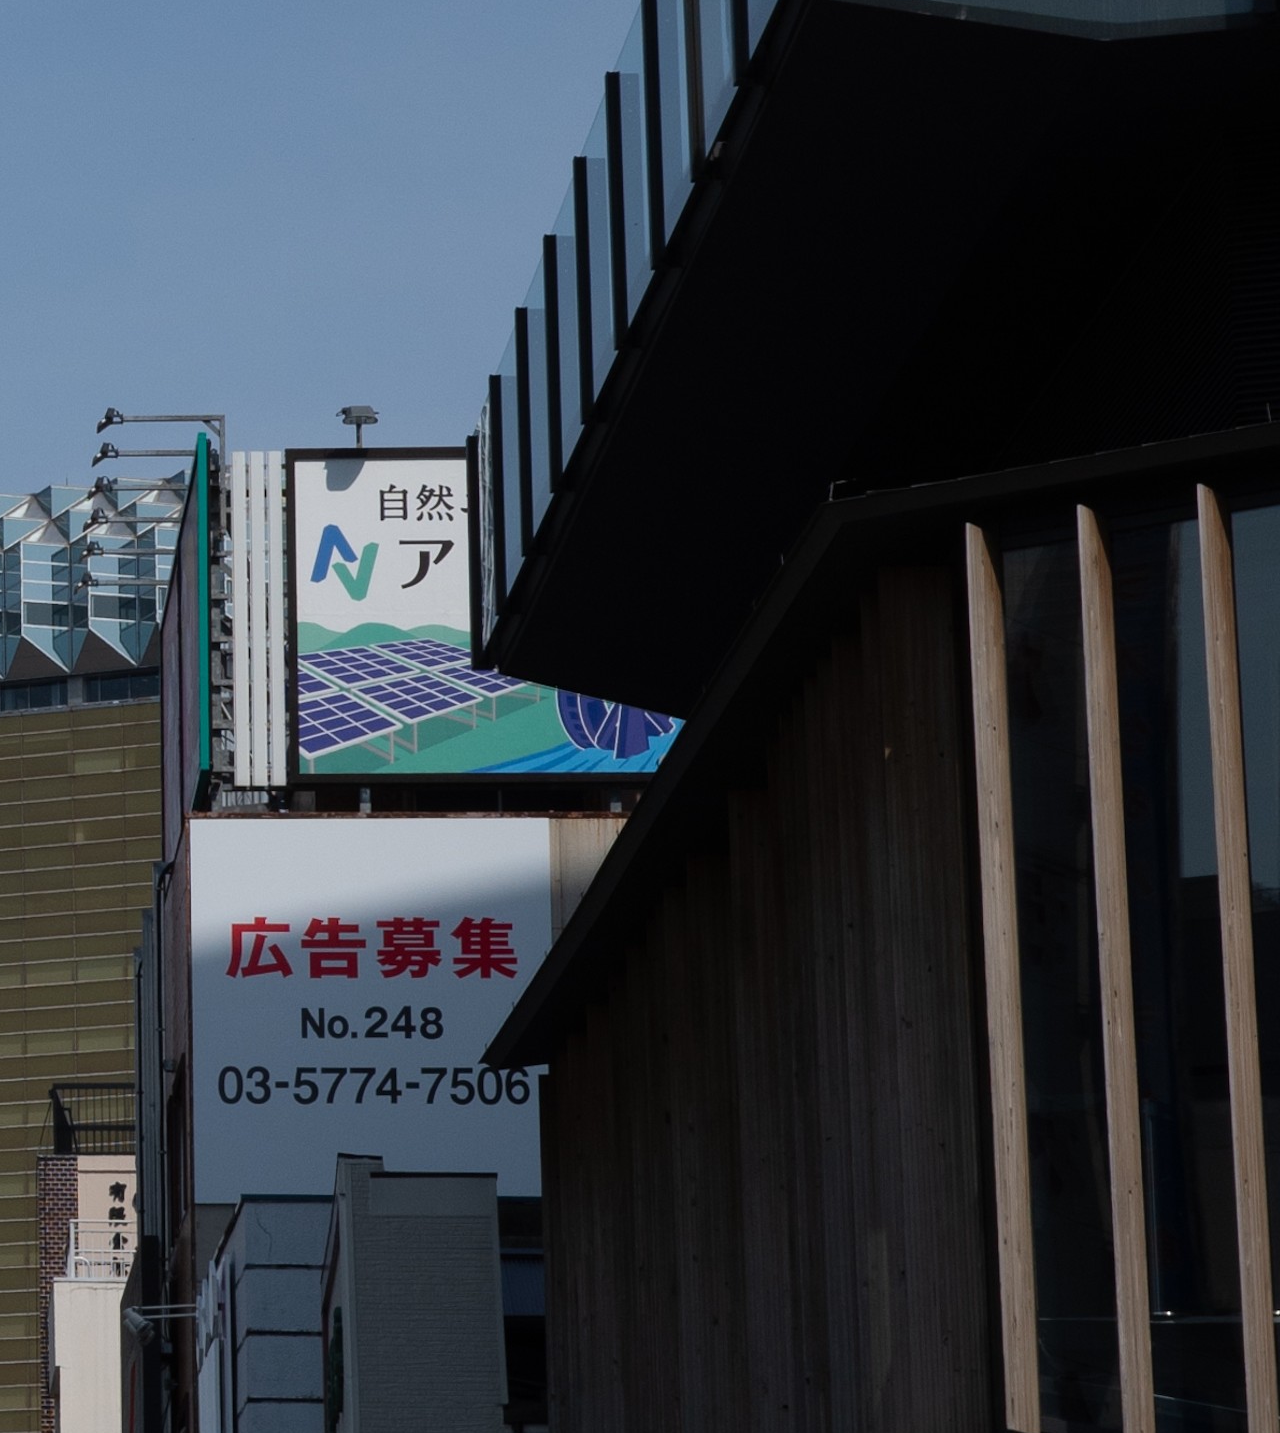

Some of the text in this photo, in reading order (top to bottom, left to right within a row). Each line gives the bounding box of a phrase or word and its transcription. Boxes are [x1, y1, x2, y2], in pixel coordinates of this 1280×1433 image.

[378, 483, 470, 524] 自然
[226, 917, 518, 979] 広告募集
[218, 1066, 530, 1105] 03-5774-7506
